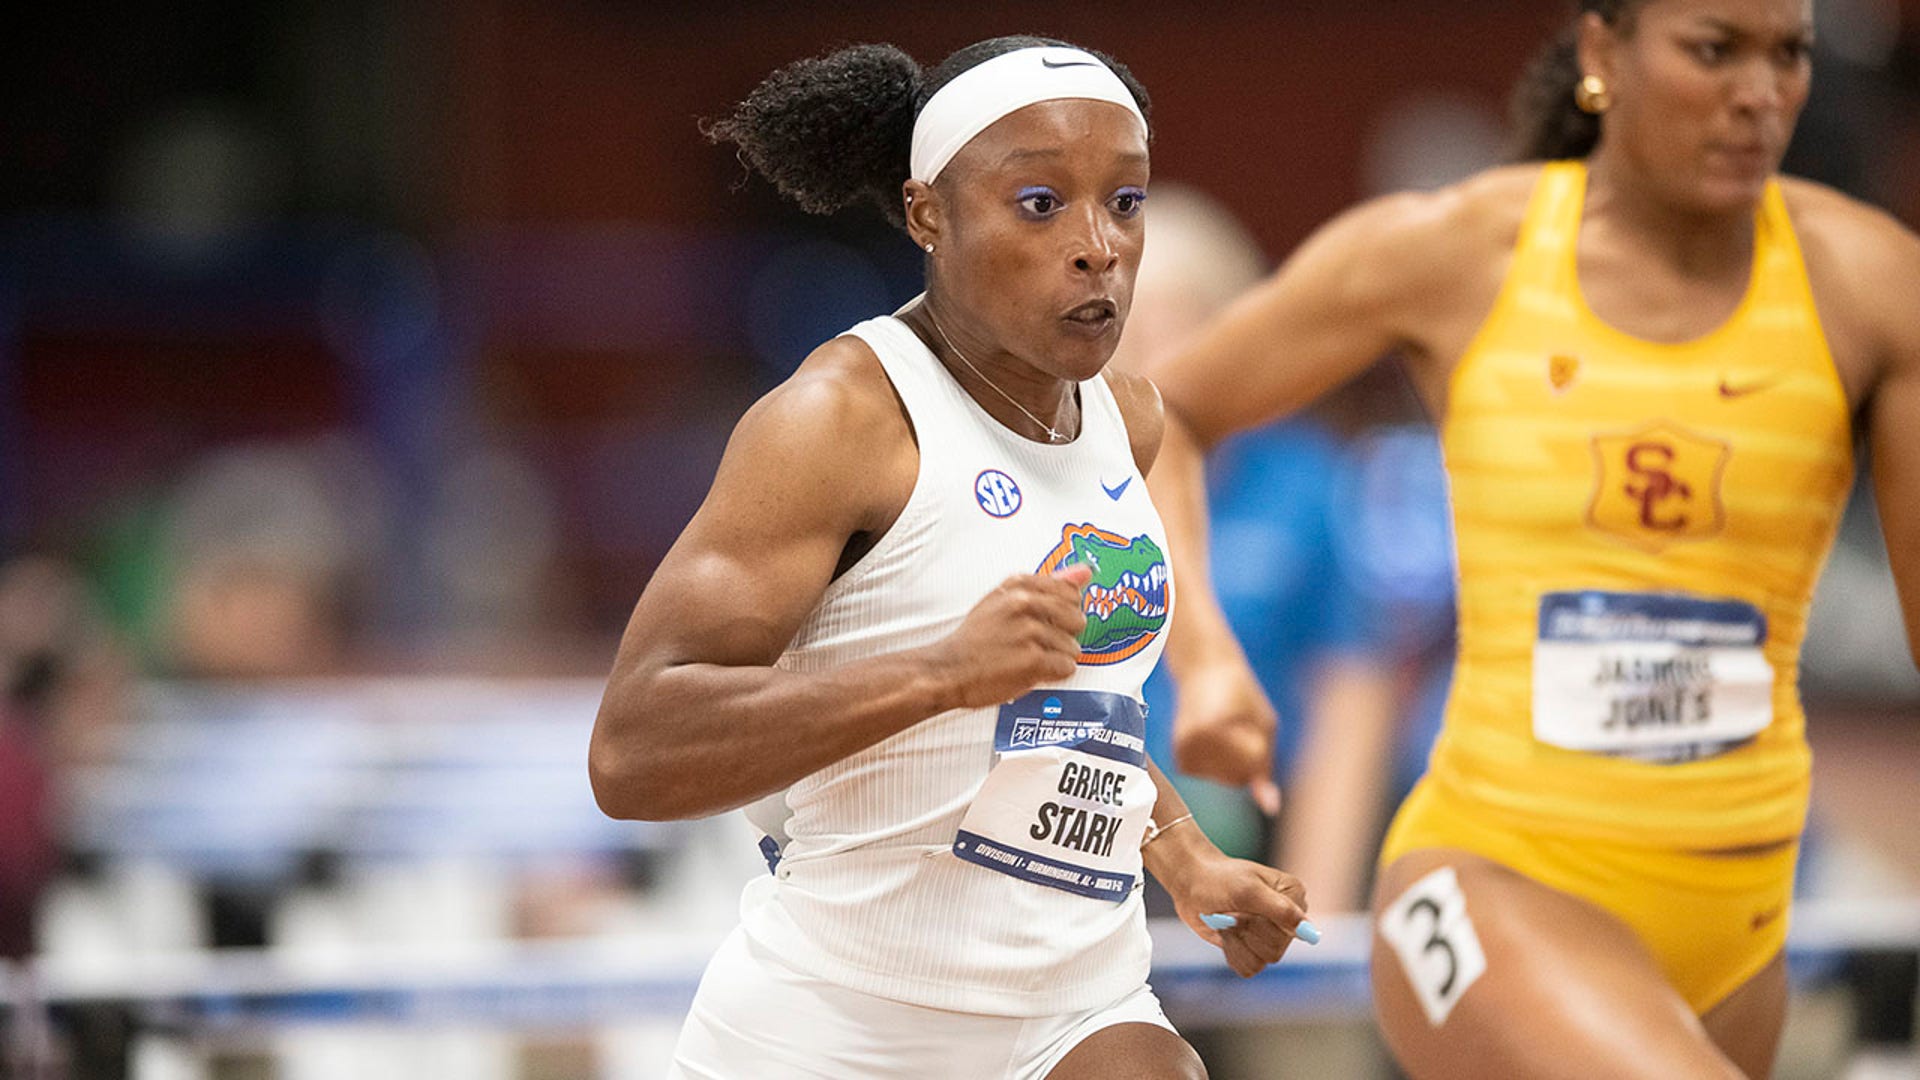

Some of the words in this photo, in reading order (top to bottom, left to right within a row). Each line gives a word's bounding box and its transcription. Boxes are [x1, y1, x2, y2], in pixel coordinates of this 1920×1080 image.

[976, 470, 1021, 517] SEC
[1624, 442, 1691, 532] SC
[1601, 690, 1712, 731] JONES
[1038, 726, 1076, 742] TRACK
[1057, 761, 1126, 807] GRACE
[1029, 802, 1123, 857] STARK
[974, 843, 1018, 866] DIVISION
[1406, 896, 1457, 998] 3
